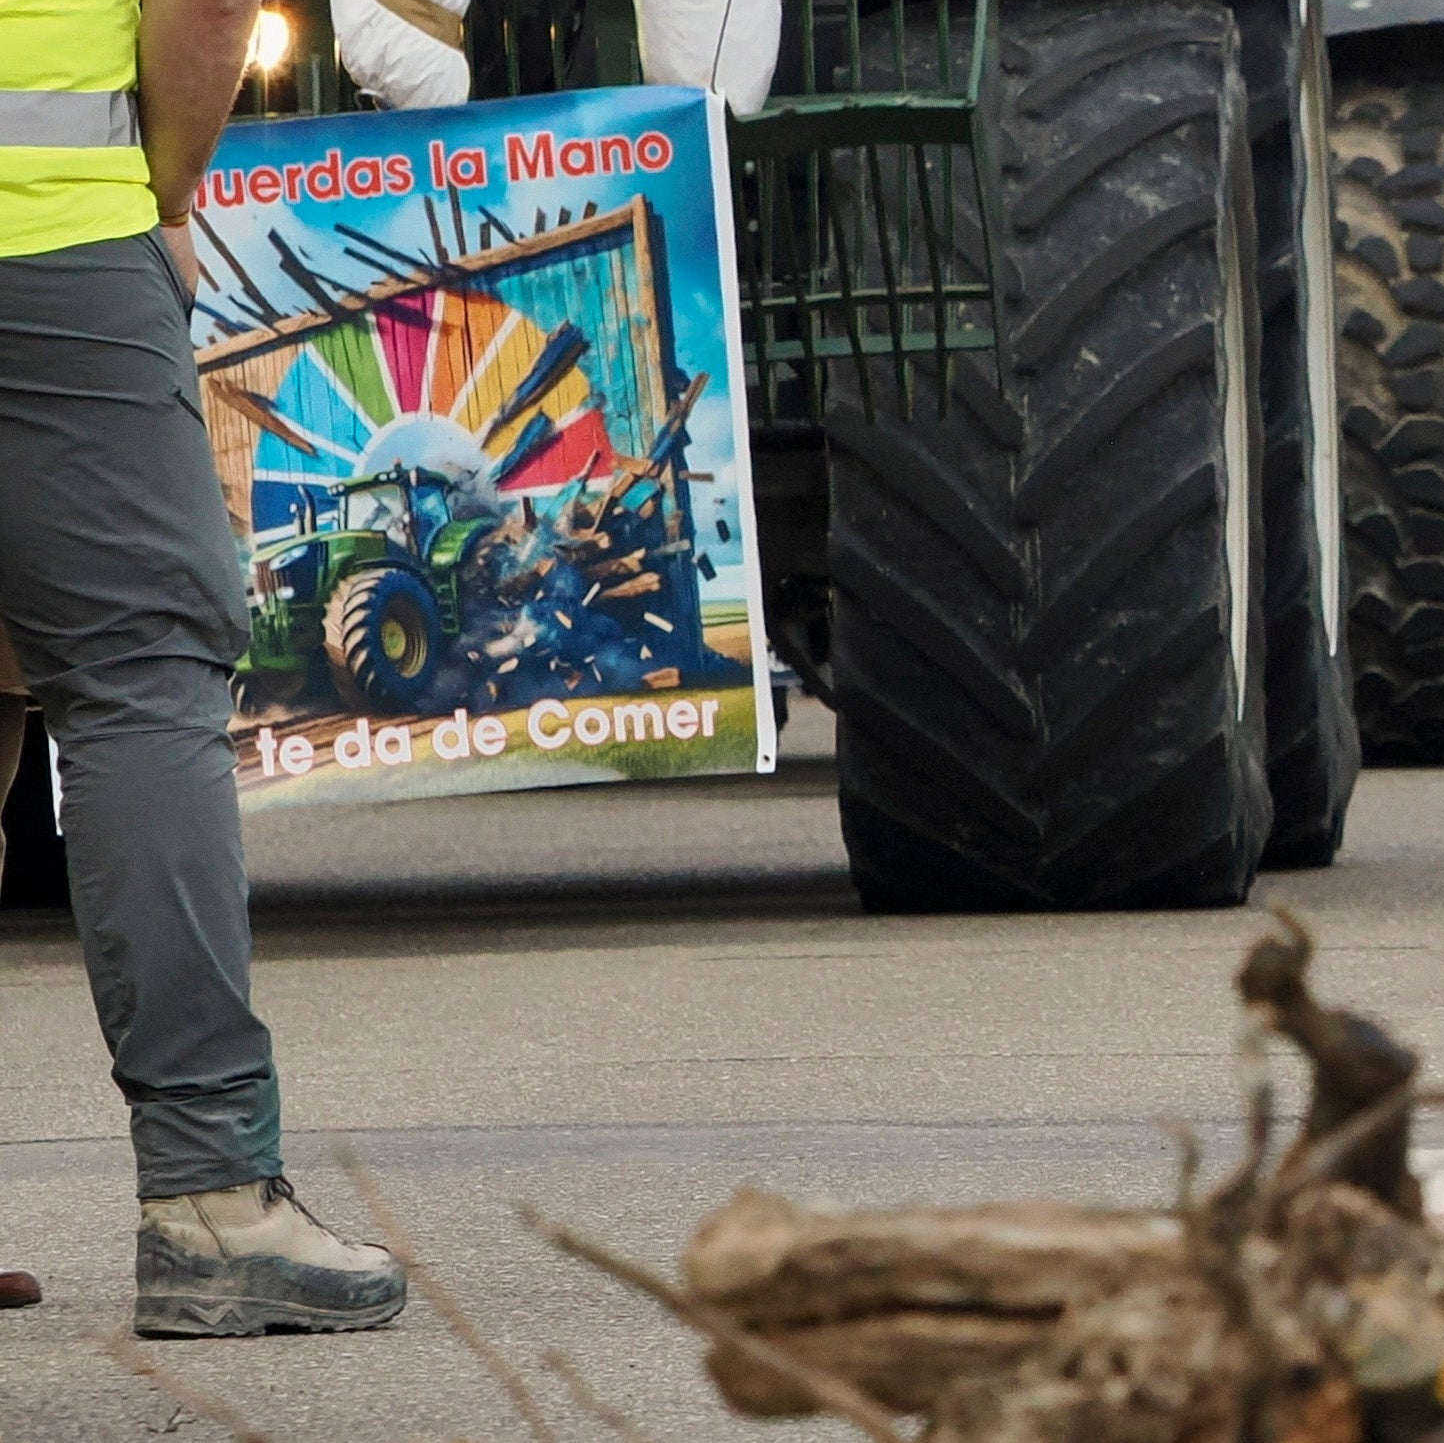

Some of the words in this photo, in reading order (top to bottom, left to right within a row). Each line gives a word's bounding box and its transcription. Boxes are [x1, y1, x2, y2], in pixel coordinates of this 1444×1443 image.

[428, 140, 487, 190] la
[506, 130, 673, 183] Mano
[256, 727, 315, 776] te
[333, 717, 413, 770] da
[431, 708, 508, 760] de
[527, 697, 720, 751] Comer
